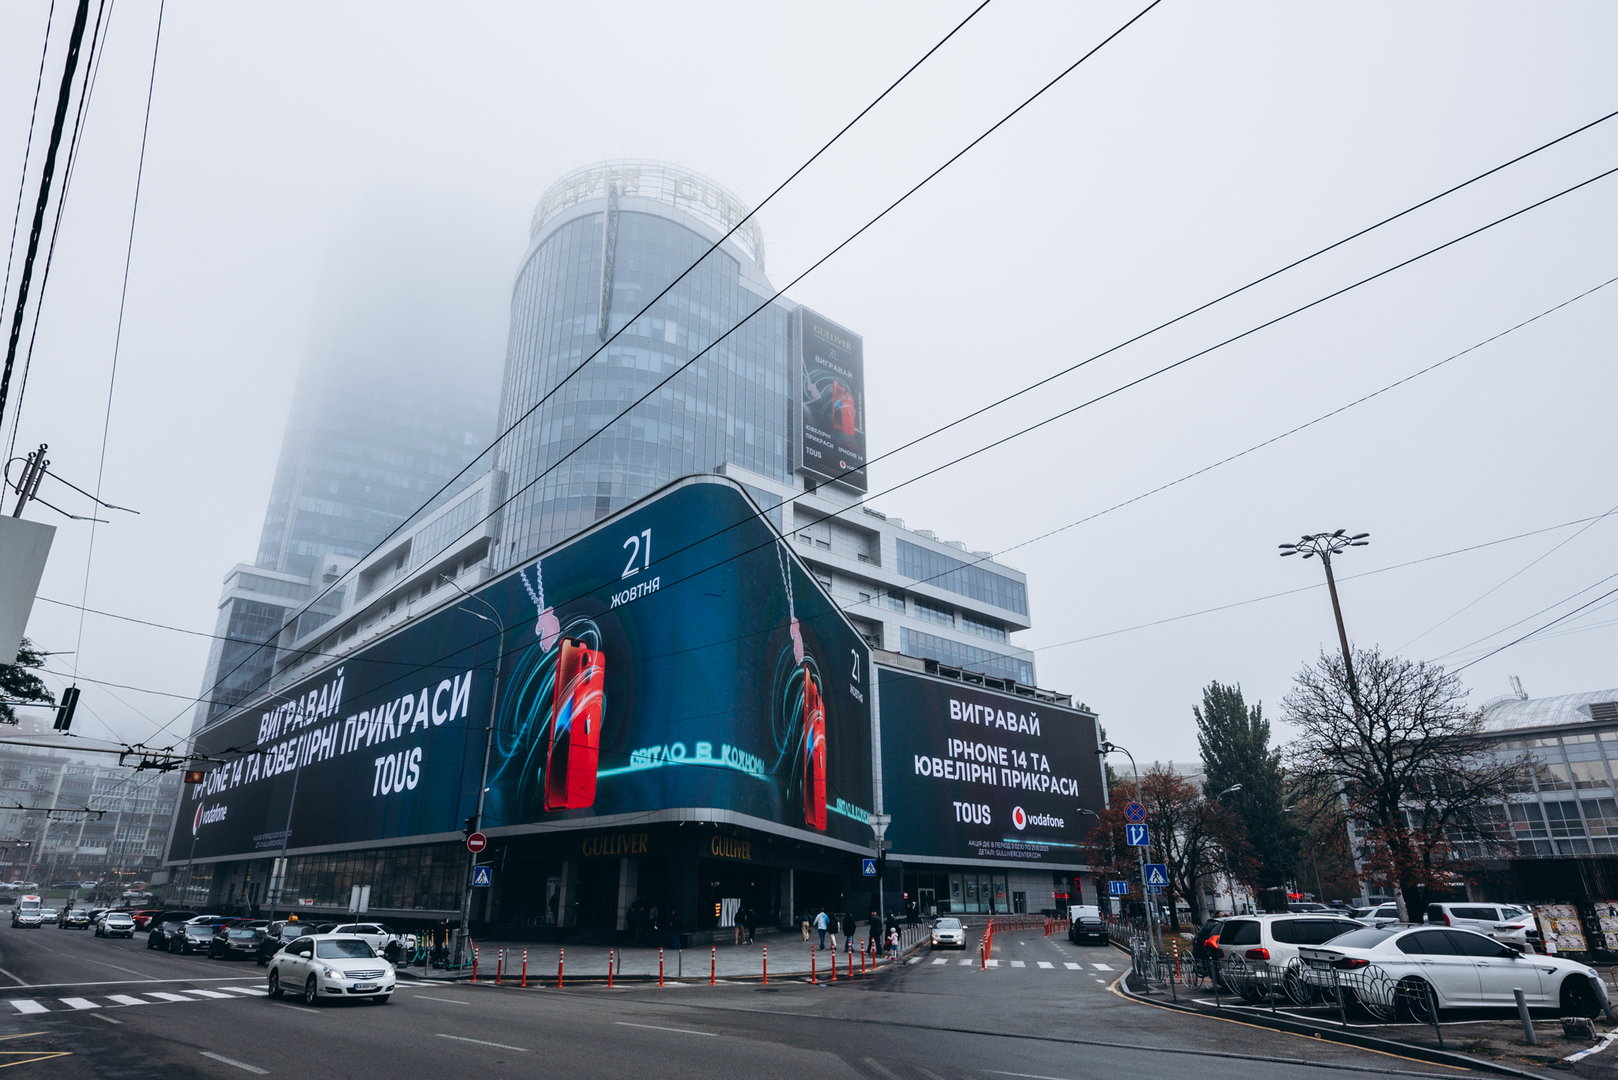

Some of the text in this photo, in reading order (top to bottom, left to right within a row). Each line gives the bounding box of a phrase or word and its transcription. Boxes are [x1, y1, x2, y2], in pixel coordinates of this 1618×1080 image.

[813, 325, 851, 350] GULLIVER
[815, 355, 853, 379] ВИГРАВАЙ
[805, 433, 834, 449] ПРИКРАСИ
[805, 446, 822, 459] TOUS
[621, 528, 652, 580] 21
[610, 576, 661, 609] ЖОВТНЯ
[851, 648, 860, 684] 21
[256, 666, 345, 745] ВИГРАВАЙ
[949, 699, 1041, 737] ВИГРАВАЙ
[230, 757, 244, 789] 14
[262, 719, 340, 778] ЮВЕЛІРНІ
[340, 670, 474, 755] ПРИКРАСИ
[695, 742, 712, 760] В
[948, 738, 1051, 773] IPHONE 14 ТА
[372, 747, 422, 797] TOUS
[914, 755, 1079, 797] ЮВЕЛІРНІ ПРИКРАСИ
[953, 801, 1065, 828] TOUS vodafone
[582, 833, 649, 857] GULLIVER
[711, 835, 751, 860] GULLIVER
